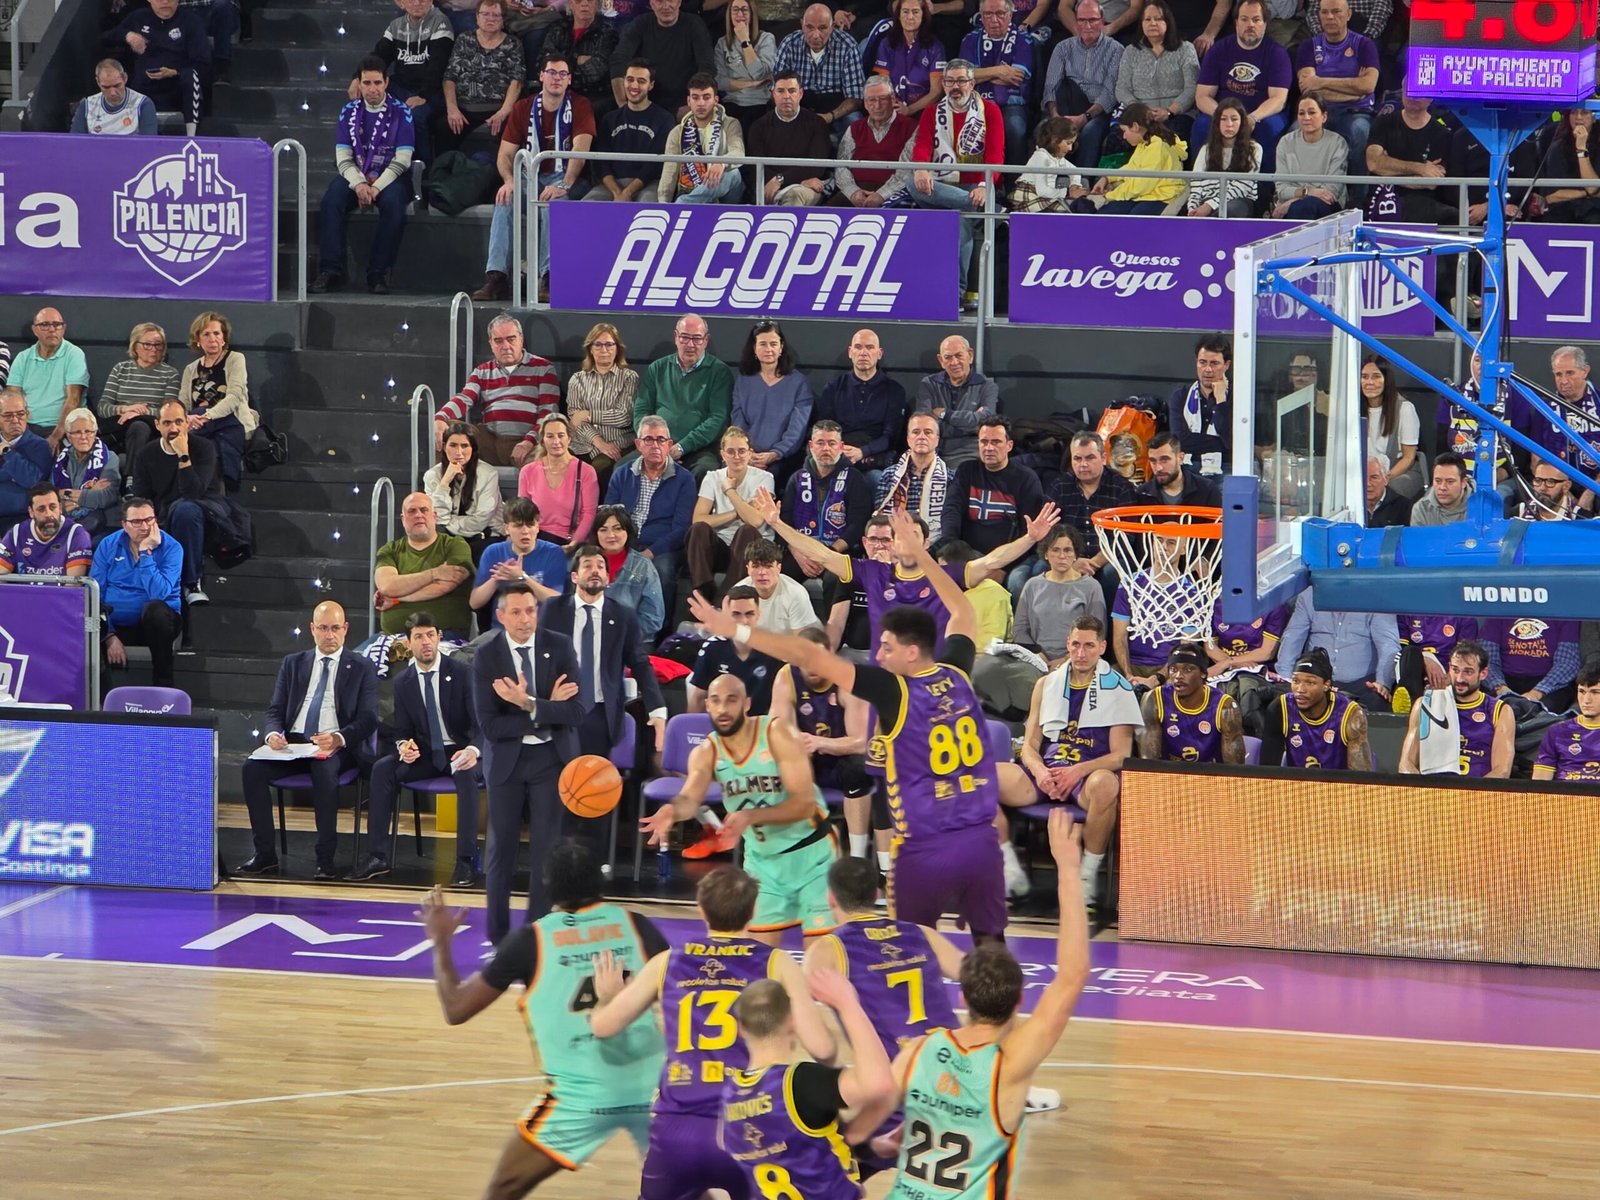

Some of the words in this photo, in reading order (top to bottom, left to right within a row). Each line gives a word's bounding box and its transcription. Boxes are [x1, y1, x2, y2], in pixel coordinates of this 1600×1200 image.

[1443, 56, 1570, 73] AYUNTAMIENTO
[1452, 71, 1472, 84] DE
[1483, 73, 1562, 87] PALENCIA
[0, 172, 81, 248] a
[120, 199, 241, 236] PALENCIA
[598, 209, 908, 312] ALCOPAL
[1110, 250, 1181, 267] Quesos
[26, 566, 64, 575] zunder
[1463, 586, 1549, 603] MONDO
[928, 715, 984, 775] 88
[722, 775, 783, 798] ALMER
[1021, 963, 1265, 990] RERA
[886, 968, 928, 1024] 7
[675, 990, 741, 1052] 13
[905, 1120, 972, 1191] 22
[753, 1163, 804, 1200] 8
